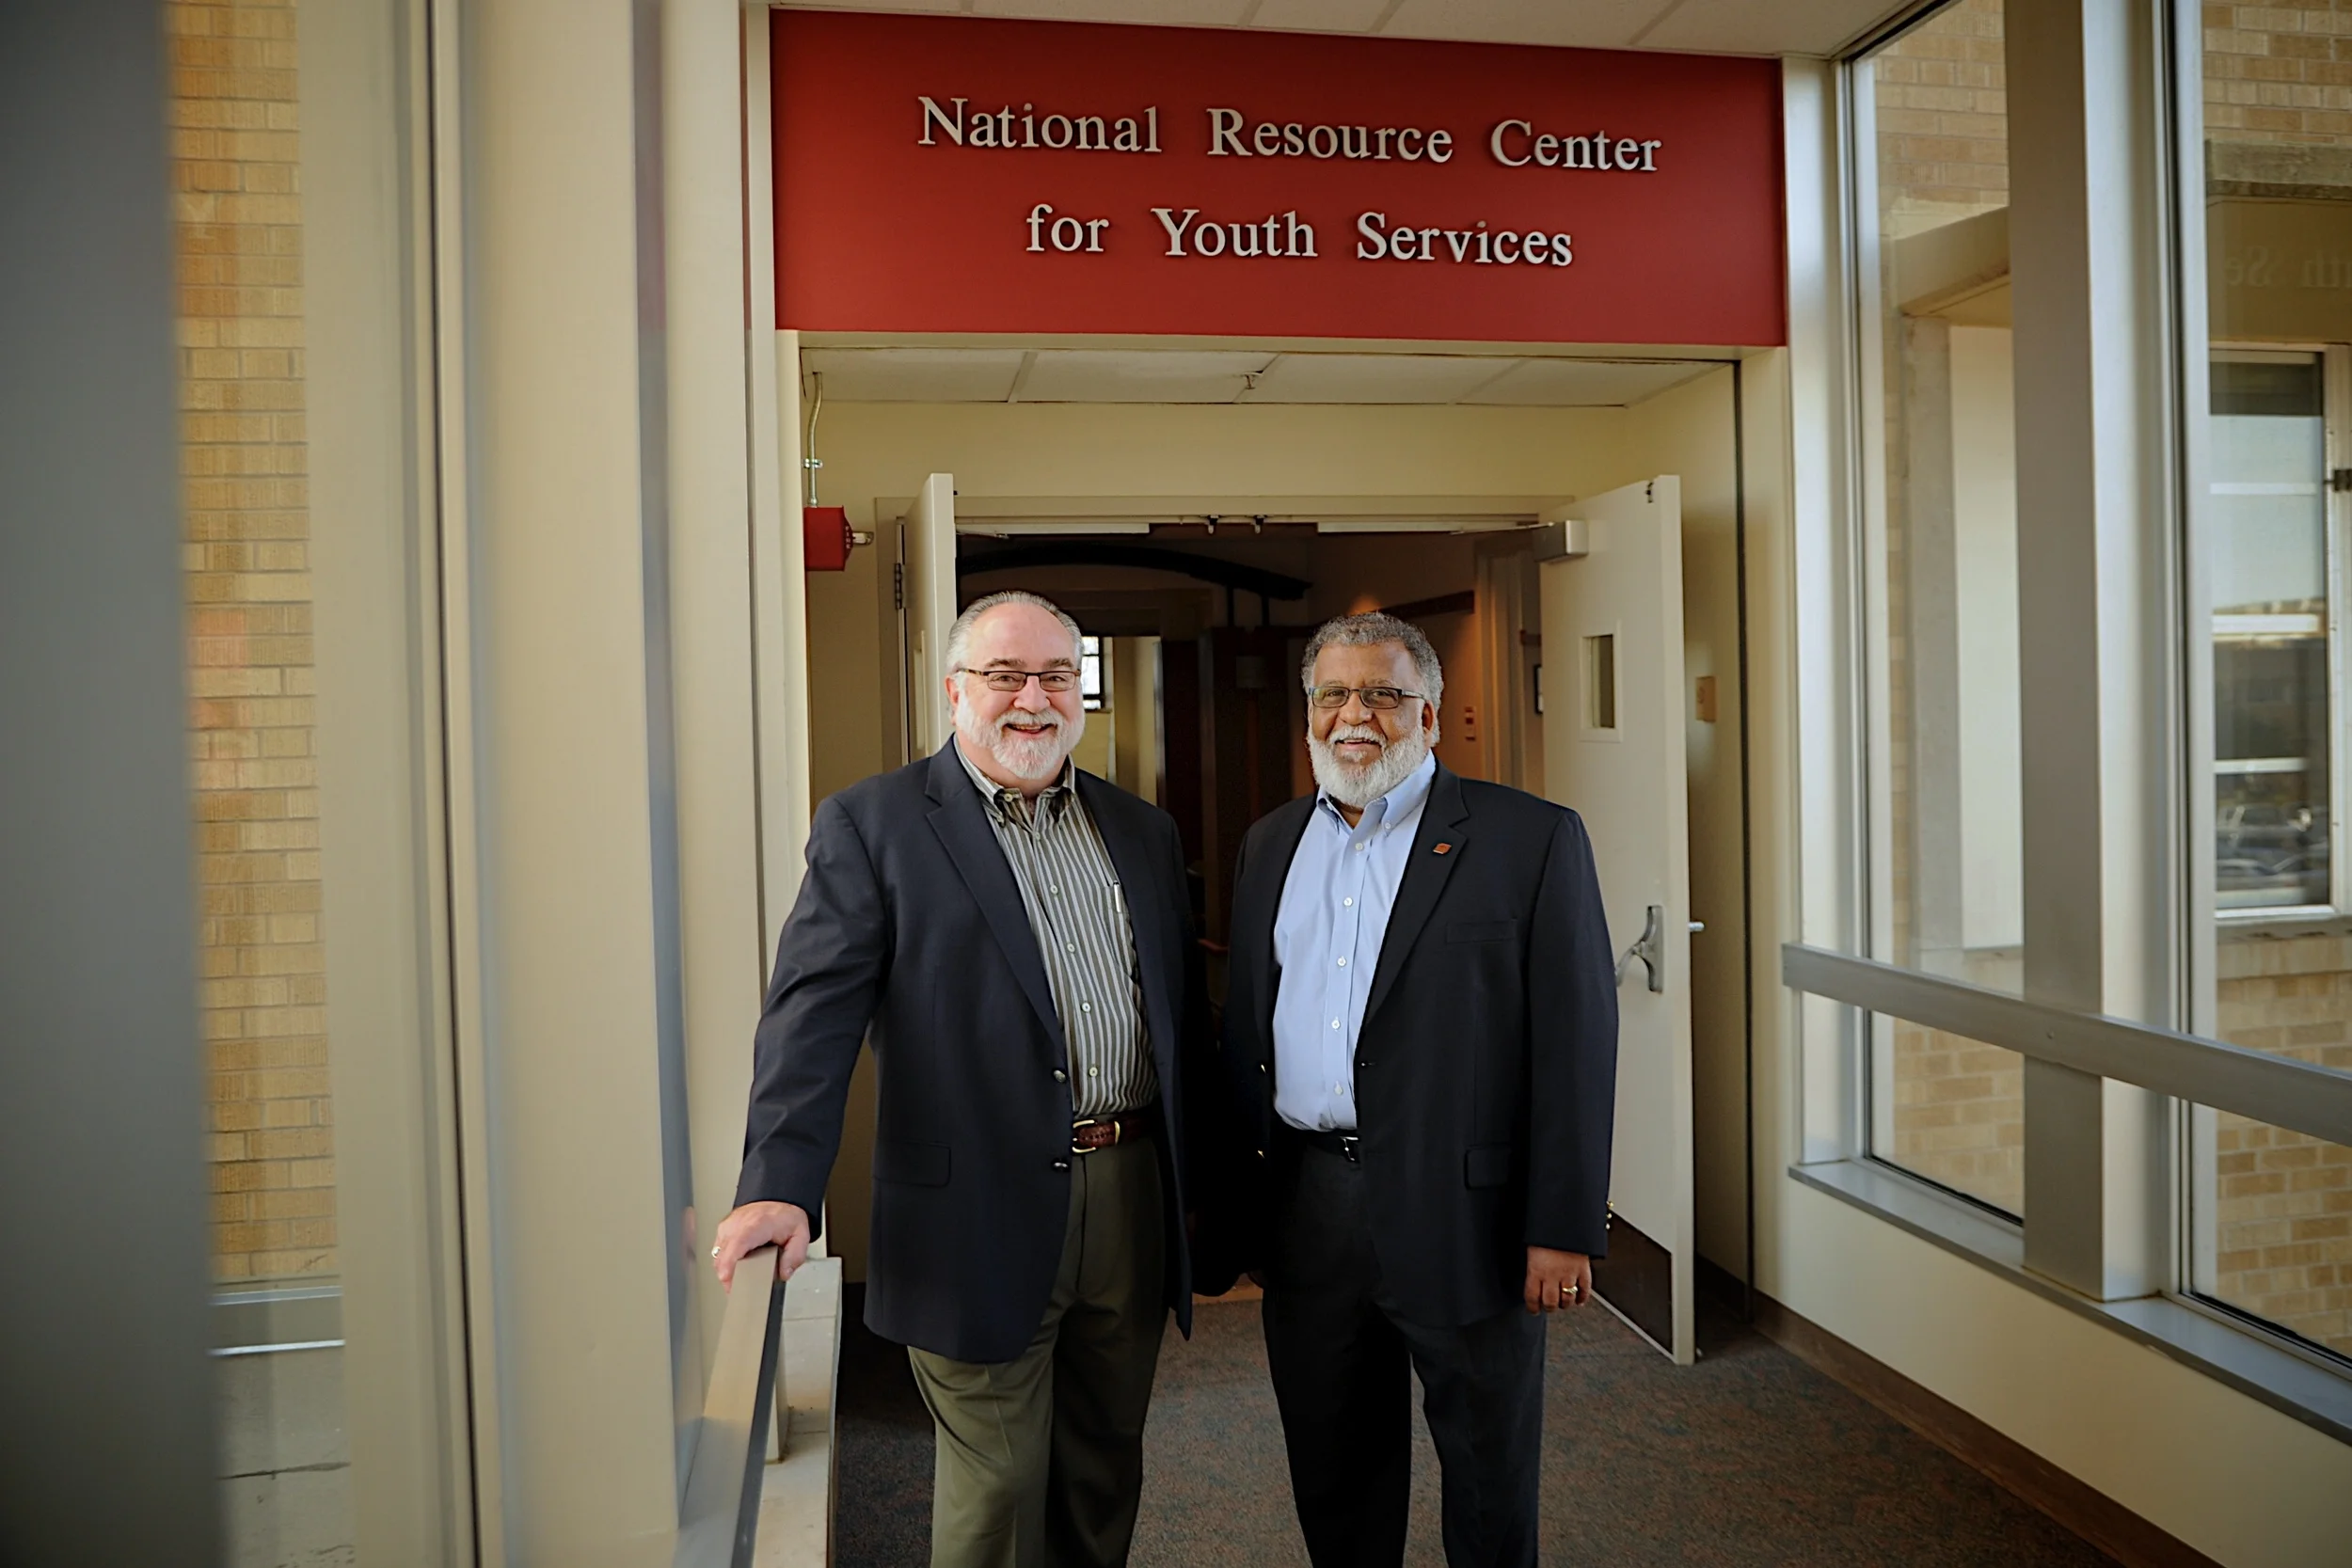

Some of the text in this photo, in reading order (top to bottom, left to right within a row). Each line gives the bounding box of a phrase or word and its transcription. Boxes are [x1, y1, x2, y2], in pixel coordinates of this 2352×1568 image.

[917, 96, 1662, 171] National Resource Center
[1025, 203, 1573, 266] for Youth Services
